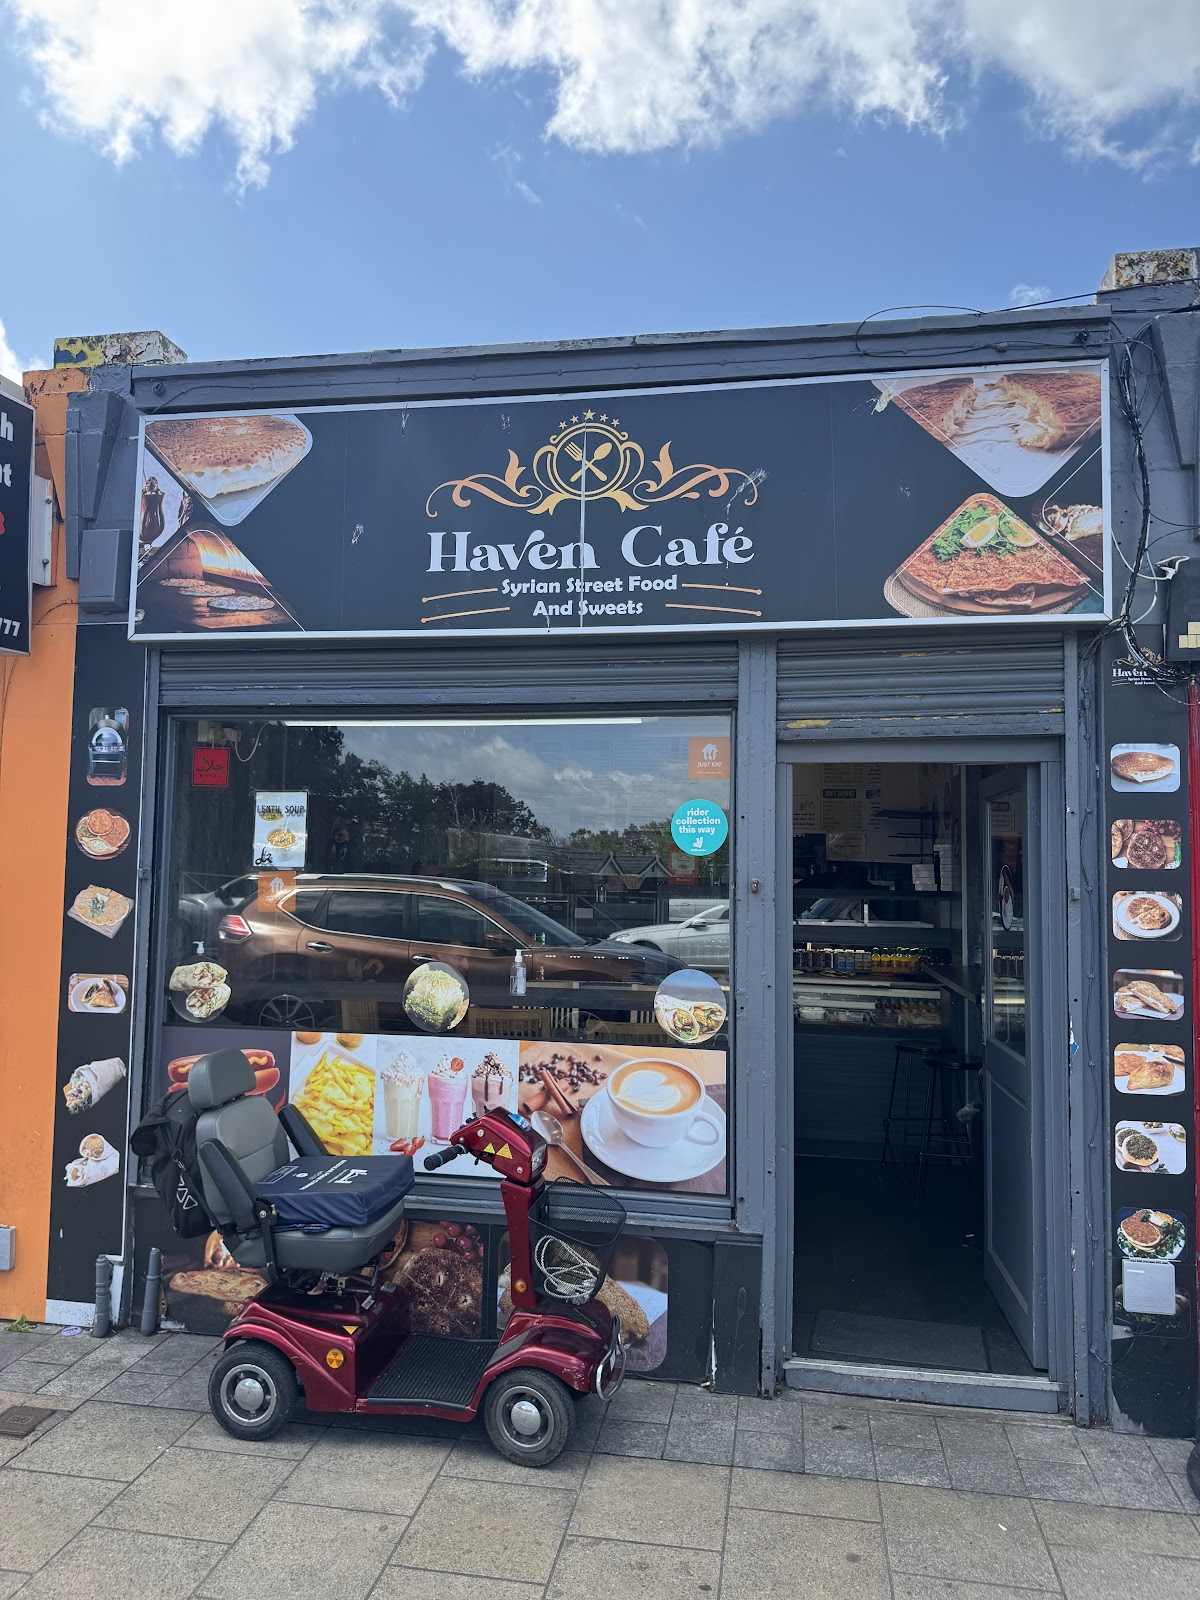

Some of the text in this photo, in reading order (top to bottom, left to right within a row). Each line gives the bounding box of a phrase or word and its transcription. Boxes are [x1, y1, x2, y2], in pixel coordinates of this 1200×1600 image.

[0, 463, 12, 488] t
[425, 522, 755, 572] Haven Café
[502, 574, 678, 597] Syrian Street Food
[533, 599, 644, 616] And Sweets
[1112, 668, 1148, 677] Haven
[196, 756, 224, 772] حلال
[257, 805, 306, 814] LENTIL SOUP
[687, 807, 709, 816] rider
[675, 816, 721, 825] collection
[678, 825, 715, 836] this way
